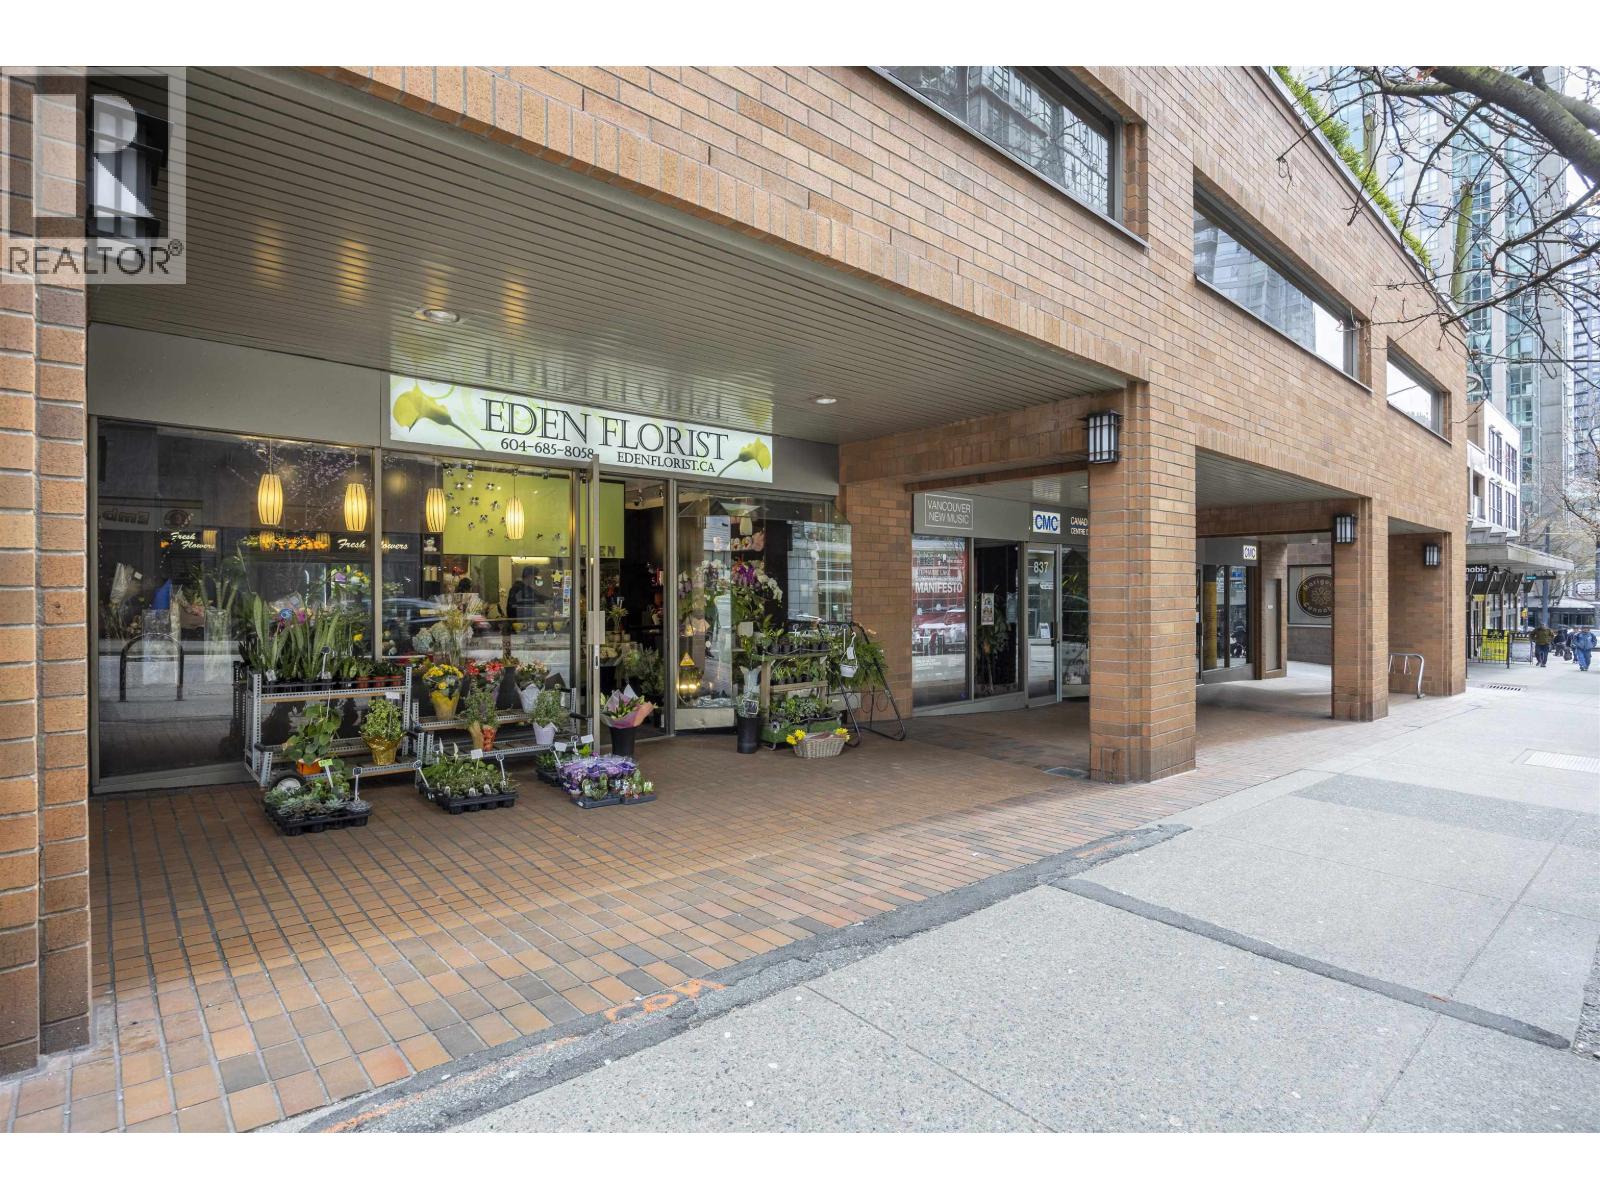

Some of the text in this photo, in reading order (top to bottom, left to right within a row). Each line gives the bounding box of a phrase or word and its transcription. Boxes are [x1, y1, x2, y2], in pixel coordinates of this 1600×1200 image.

[480, 398, 729, 461] EDEN FLORIST
[500, 437, 594, 460] 604-685-8058
[617, 451, 716, 473] EDENFLORIST.CA
[927, 500, 972, 513] VANCOUVER
[928, 511, 970, 524] NEW MUSIC
[1035, 514, 1058, 531] CMC
[171, 531, 196, 541] Fresh
[180, 541, 215, 550] Flowers
[337, 538, 366, 549] Fresh
[1033, 561, 1049, 574] 837
[915, 582, 963, 593] MANIFESTO
